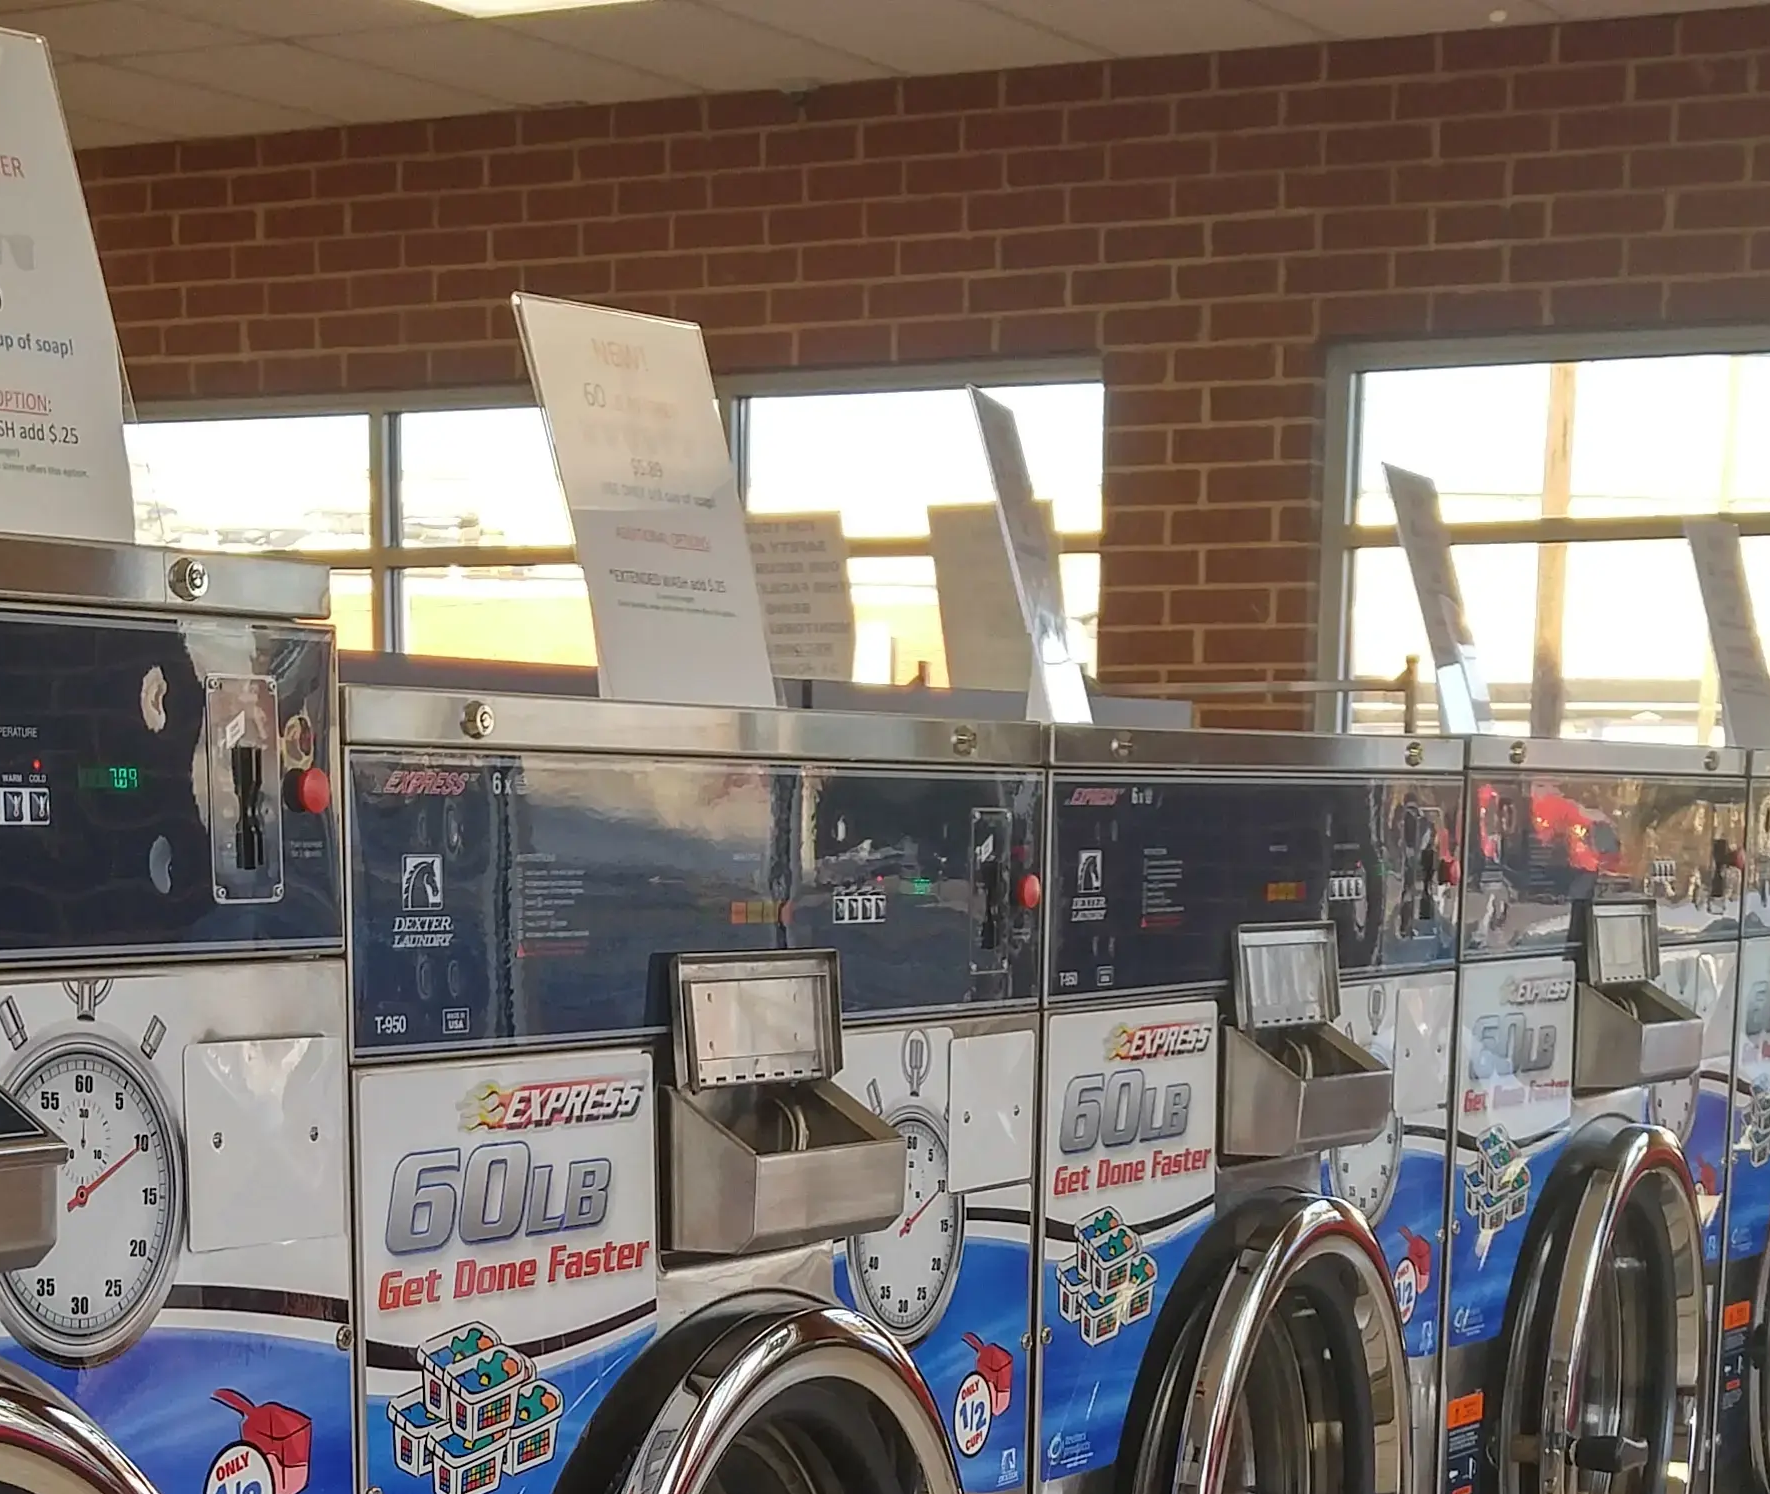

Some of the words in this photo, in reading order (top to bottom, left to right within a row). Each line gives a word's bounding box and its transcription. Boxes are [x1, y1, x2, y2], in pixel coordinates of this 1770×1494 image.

[17, 334, 31, 349] of
[35, 339, 74, 359] soap!
[583, 382, 606, 408] 60
[19, 425, 45, 441] add
[48, 426, 79, 446] $.25
[383, 771, 469, 796] EXPRESS
[492, 772, 502, 795] 6
[392, 916, 452, 933] DEXTER
[392, 934, 454, 948] LAUNDRY
[375, 1015, 407, 1034] T-950
[448, 1020, 464, 1030] USA
[1131, 1024, 1211, 1060] EXPRESS
[74, 1074, 95, 1096] 60
[40, 1089, 60, 1111] 55
[114, 1089, 125, 1112] 5
[503, 1081, 645, 1130] EXPRESS
[132, 1133, 151, 1154] 10
[906, 1136, 918, 1150] 60
[928, 1149, 934, 1162] 5
[1054, 1166, 1091, 1197] Get
[1096, 1157, 1146, 1189] Done
[1150, 1146, 1211, 1178] Faster
[141, 1186, 158, 1207] 15
[940, 1219, 949, 1233] 15
[129, 1238, 147, 1259] 20
[869, 1257, 879, 1270] 40
[931, 1258, 942, 1271] 20
[378, 1269, 442, 1313] Get
[453, 1259, 538, 1300] Done
[547, 1240, 651, 1284] Faster
[36, 1277, 56, 1298] 35
[104, 1277, 123, 1298] 25
[880, 1285, 891, 1299] 35
[917, 1287, 927, 1301] 25
[71, 1294, 91, 1316] 30
[898, 1299, 909, 1313] 30
[961, 1379, 980, 1401] ONLY
[960, 1401, 987, 1431] 1/2
[965, 1431, 983, 1451] CUP!
[215, 1451, 250, 1483] ONLY
